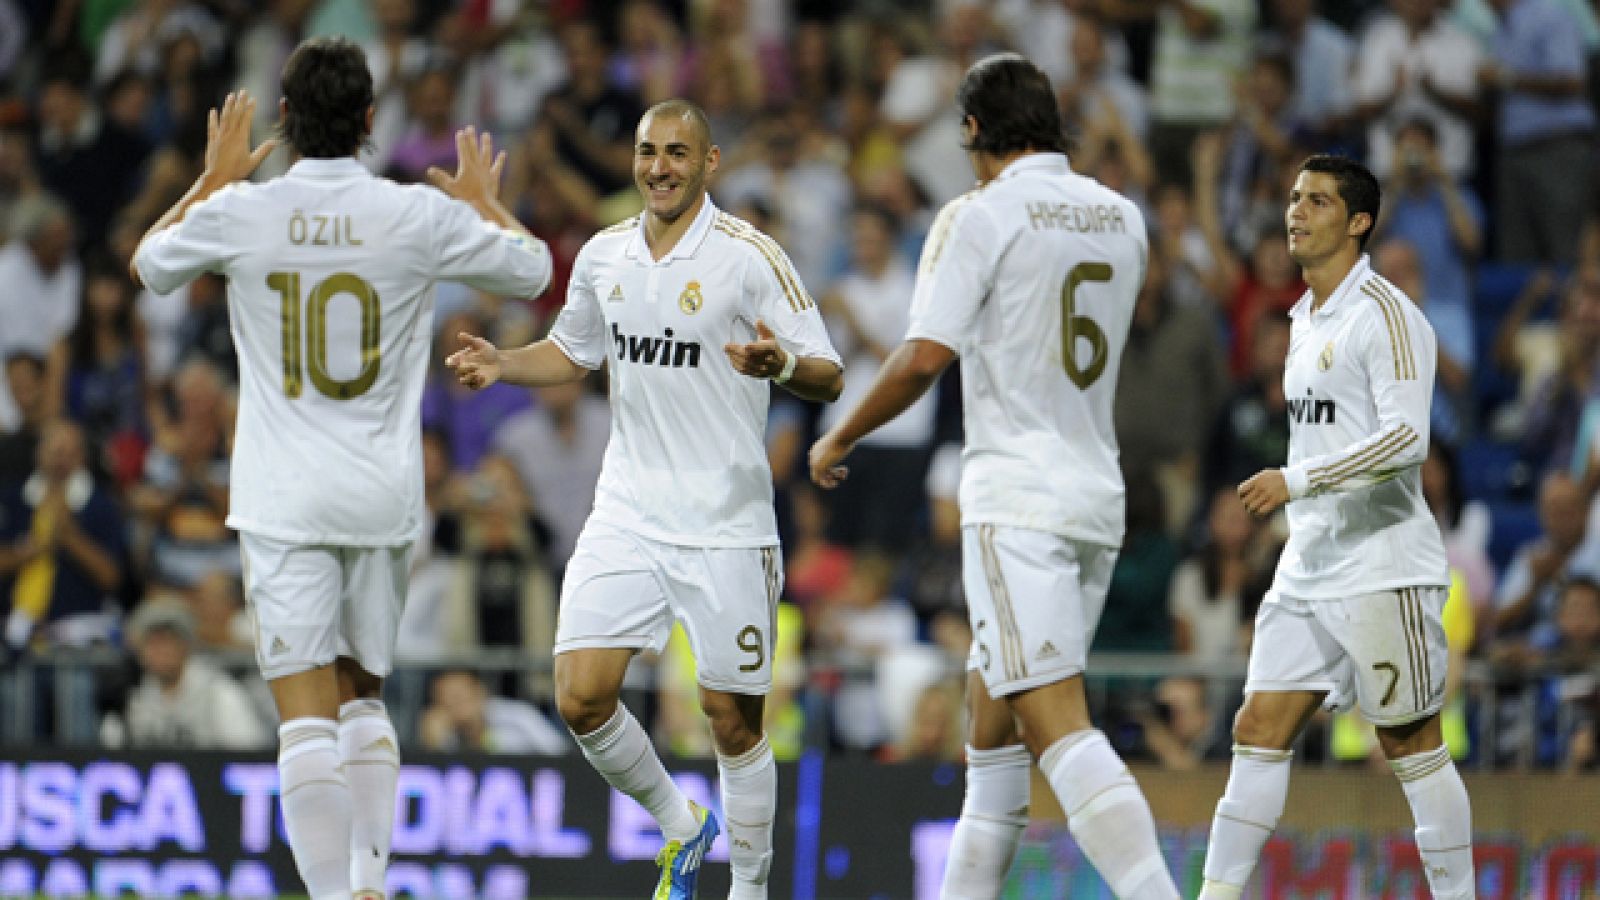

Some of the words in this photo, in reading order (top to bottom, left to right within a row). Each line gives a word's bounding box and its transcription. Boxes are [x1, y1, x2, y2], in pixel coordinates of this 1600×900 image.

[288, 208, 364, 246] ÖZIL
[265, 271, 382, 401] 10
[1061, 261, 1113, 392] 6
[1287, 387, 1336, 426] win
[736, 624, 764, 673] 9
[1372, 660, 1400, 708] 7
